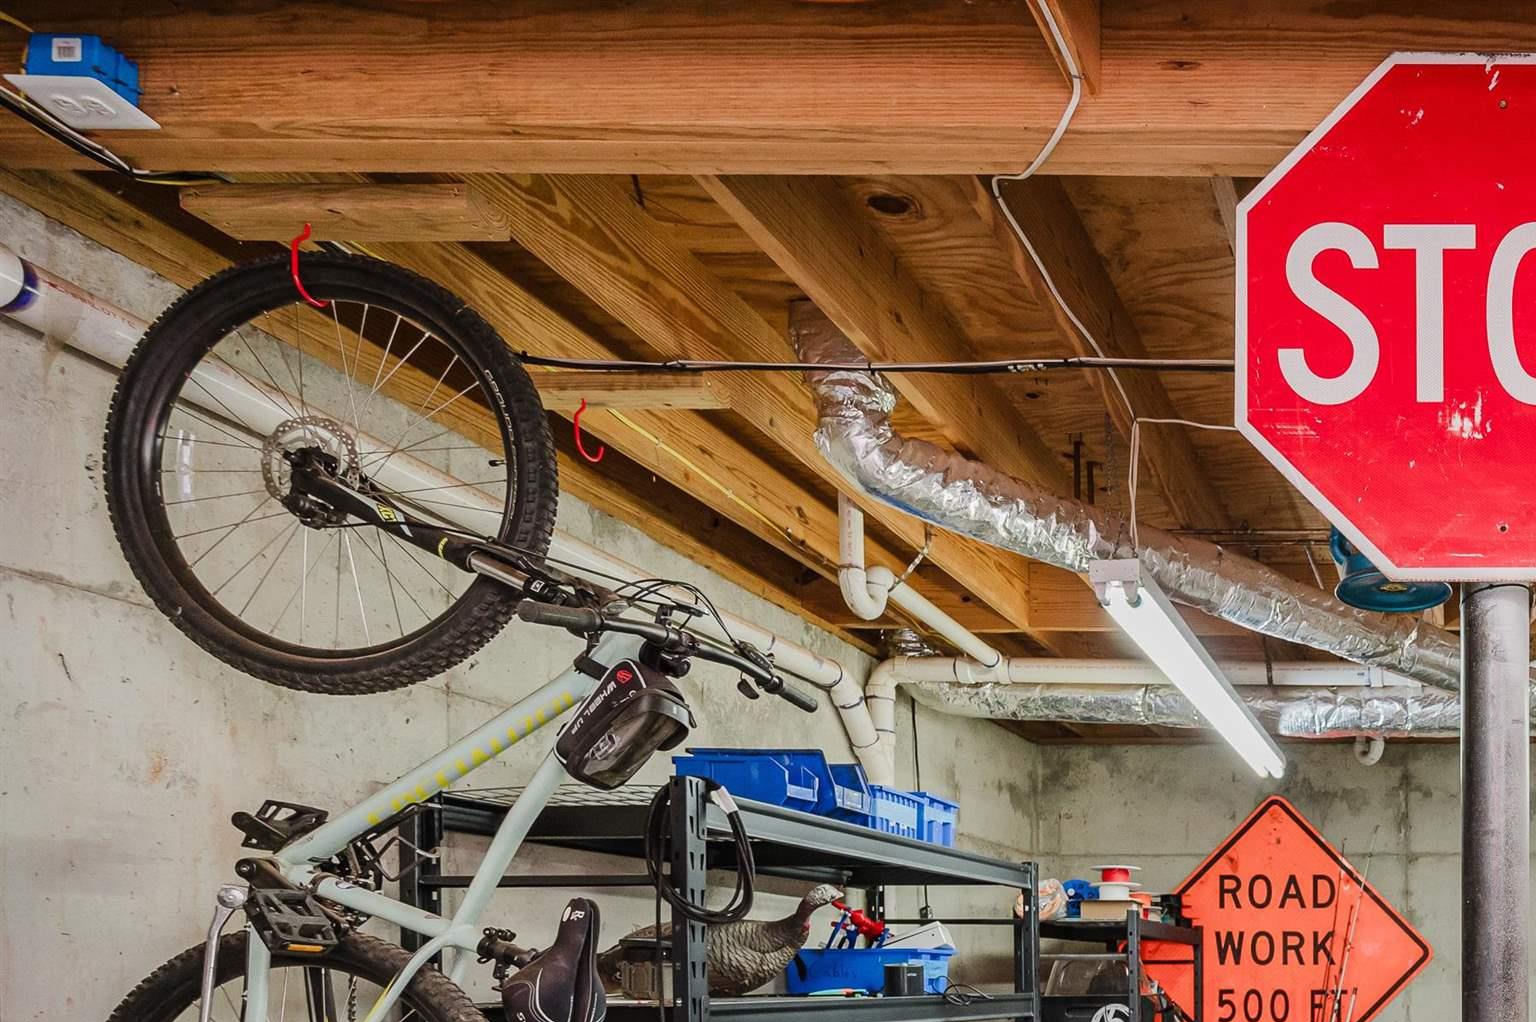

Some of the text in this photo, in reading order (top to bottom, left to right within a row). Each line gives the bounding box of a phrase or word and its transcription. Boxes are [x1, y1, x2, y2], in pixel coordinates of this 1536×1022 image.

[571, 681, 617, 735] WHEEL UP
[1218, 874, 1336, 909] ROAD
[1214, 931, 1336, 966] WORK
